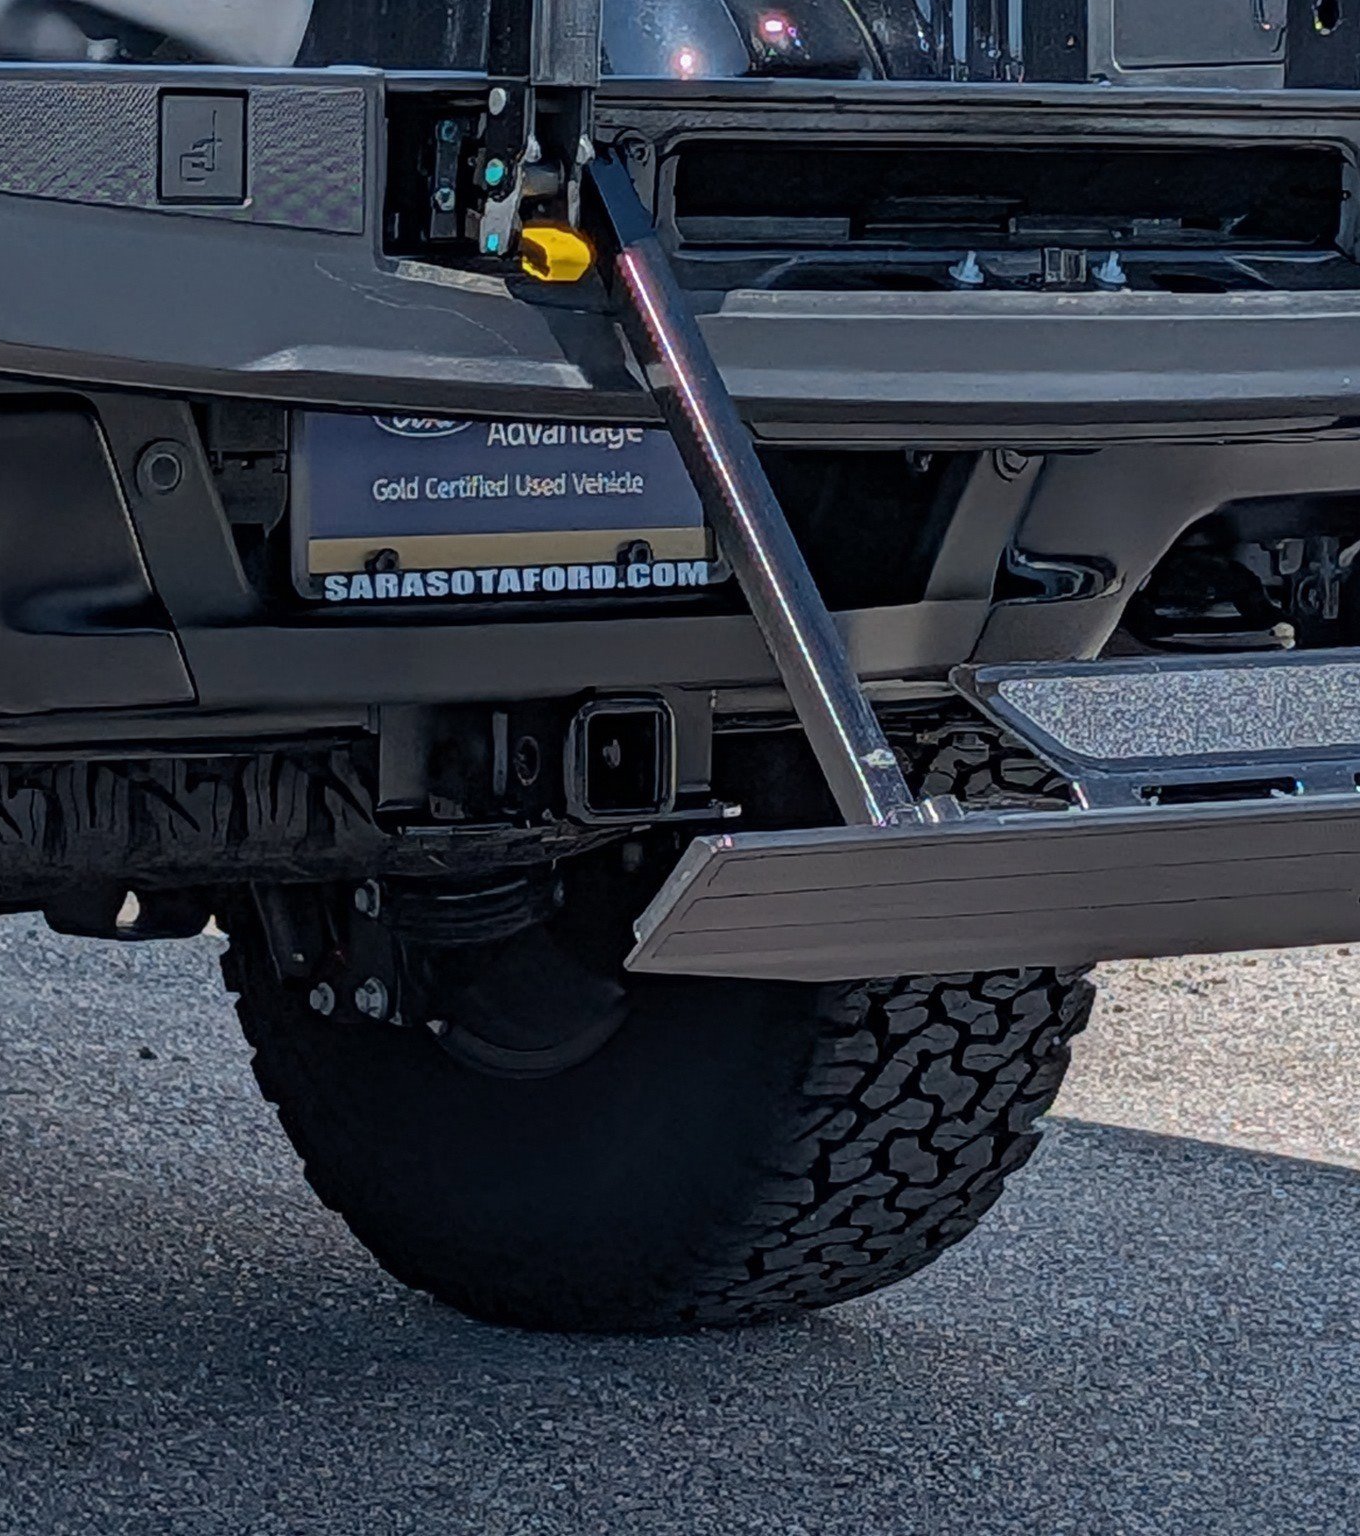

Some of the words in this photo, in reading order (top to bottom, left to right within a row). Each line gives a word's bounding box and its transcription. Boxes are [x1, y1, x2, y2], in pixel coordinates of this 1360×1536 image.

[372, 477, 419, 501] Gold
[424, 473, 509, 499] Certified
[515, 473, 567, 497] Used
[571, 470, 645, 495] Vehicle
[324, 561, 709, 602] SARASOTAFORD.COM
